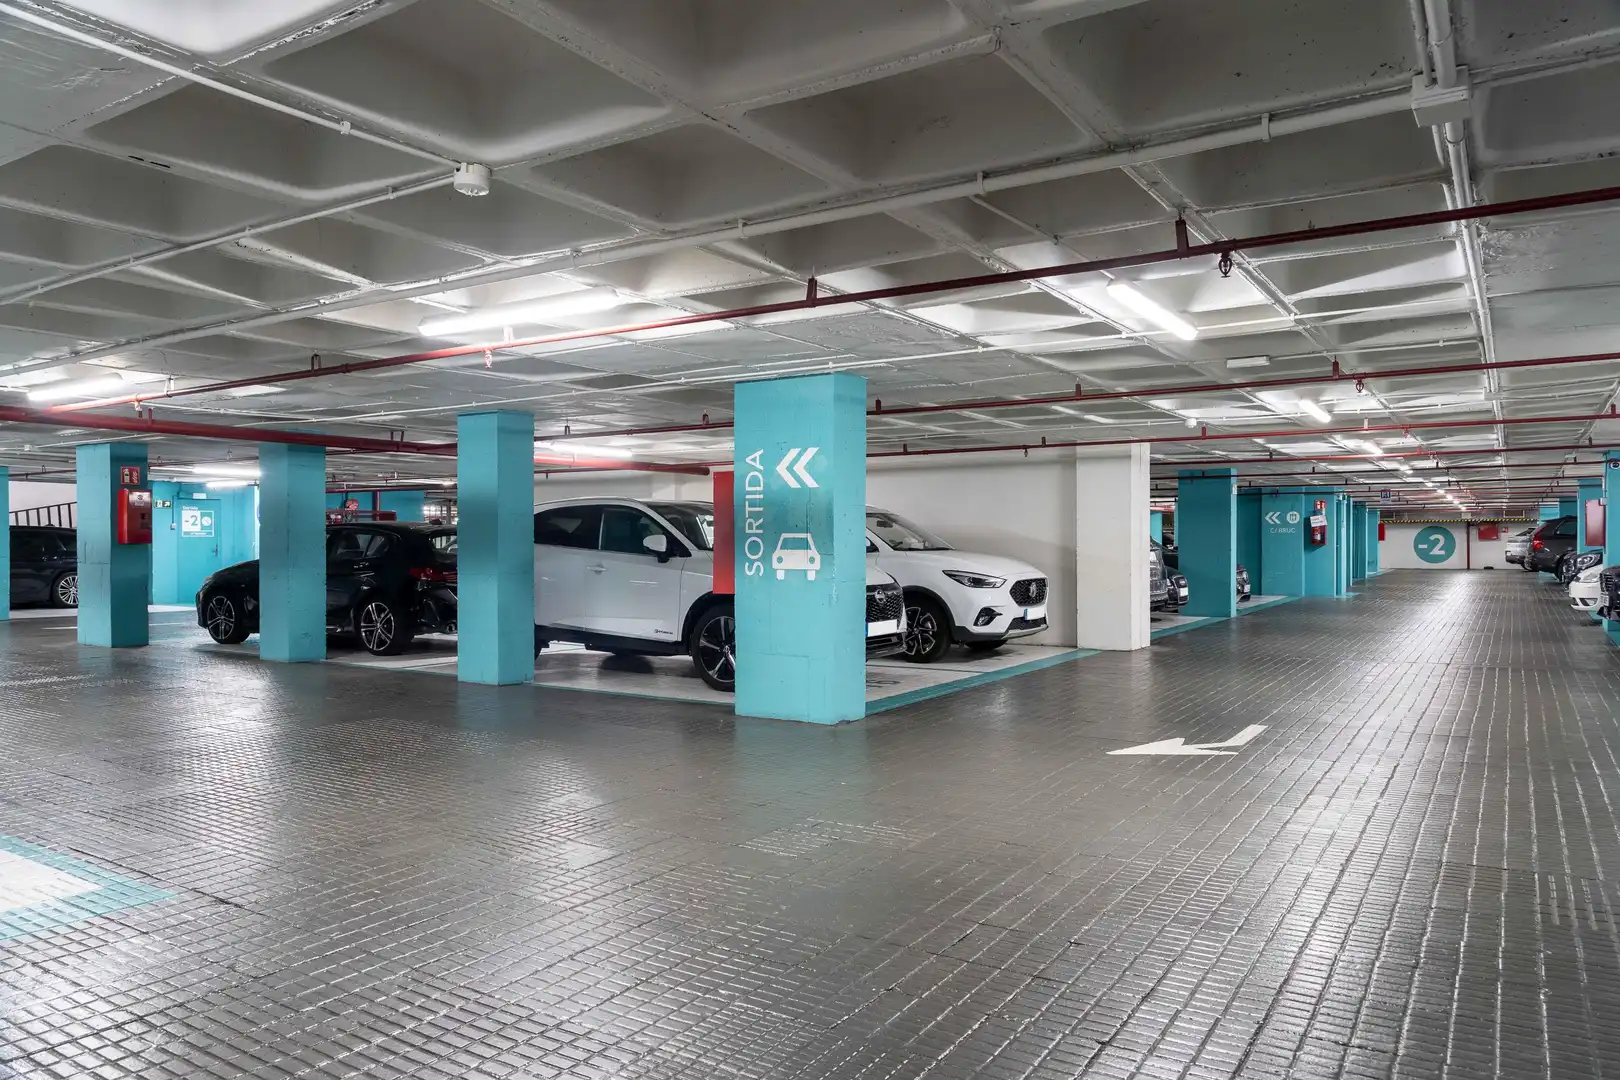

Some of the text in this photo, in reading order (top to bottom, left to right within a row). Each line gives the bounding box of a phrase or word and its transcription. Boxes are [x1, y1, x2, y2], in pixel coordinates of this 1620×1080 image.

[184, 514, 198, 526] -2
[744, 448, 764, 577] SORTIDA
[1417, 534, 1446, 555] -2
